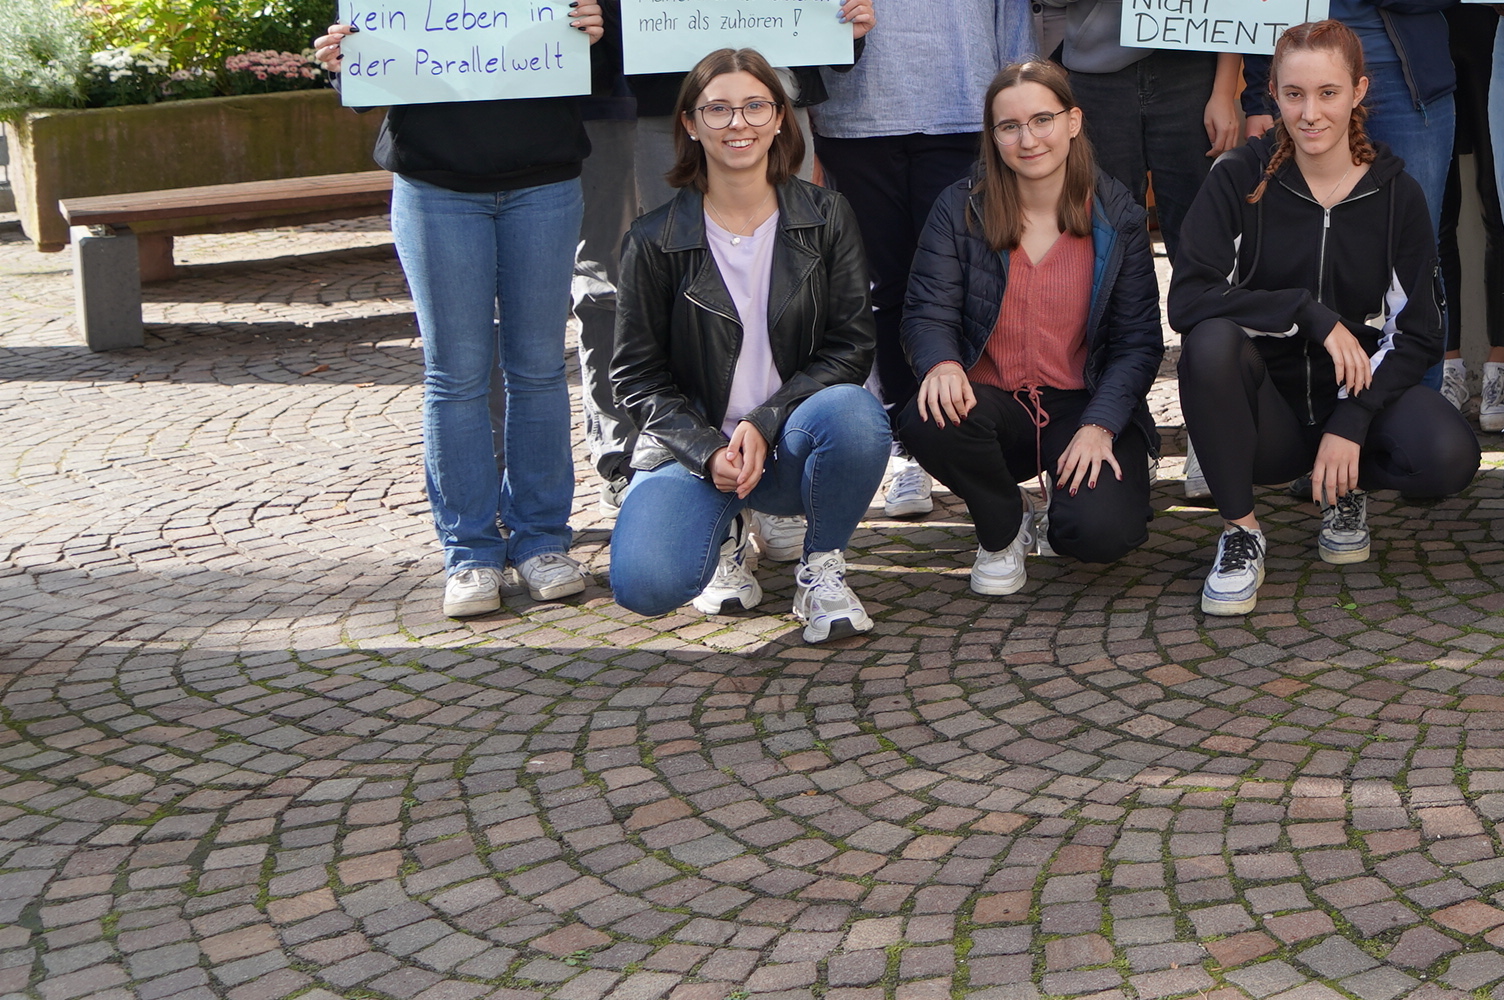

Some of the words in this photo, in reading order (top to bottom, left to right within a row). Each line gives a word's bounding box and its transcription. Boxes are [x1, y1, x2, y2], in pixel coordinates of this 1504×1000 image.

[350, 2, 406, 32] kein
[530, 2, 554, 22] in
[639, 12, 678, 32] mehr
[688, 10, 710, 30] als
[720, 9, 783, 30] zuhören
[1135, 13, 1289, 47] DEMENT
[349, 52, 396, 77] der
[415, 42, 564, 76] Parallelwelt
